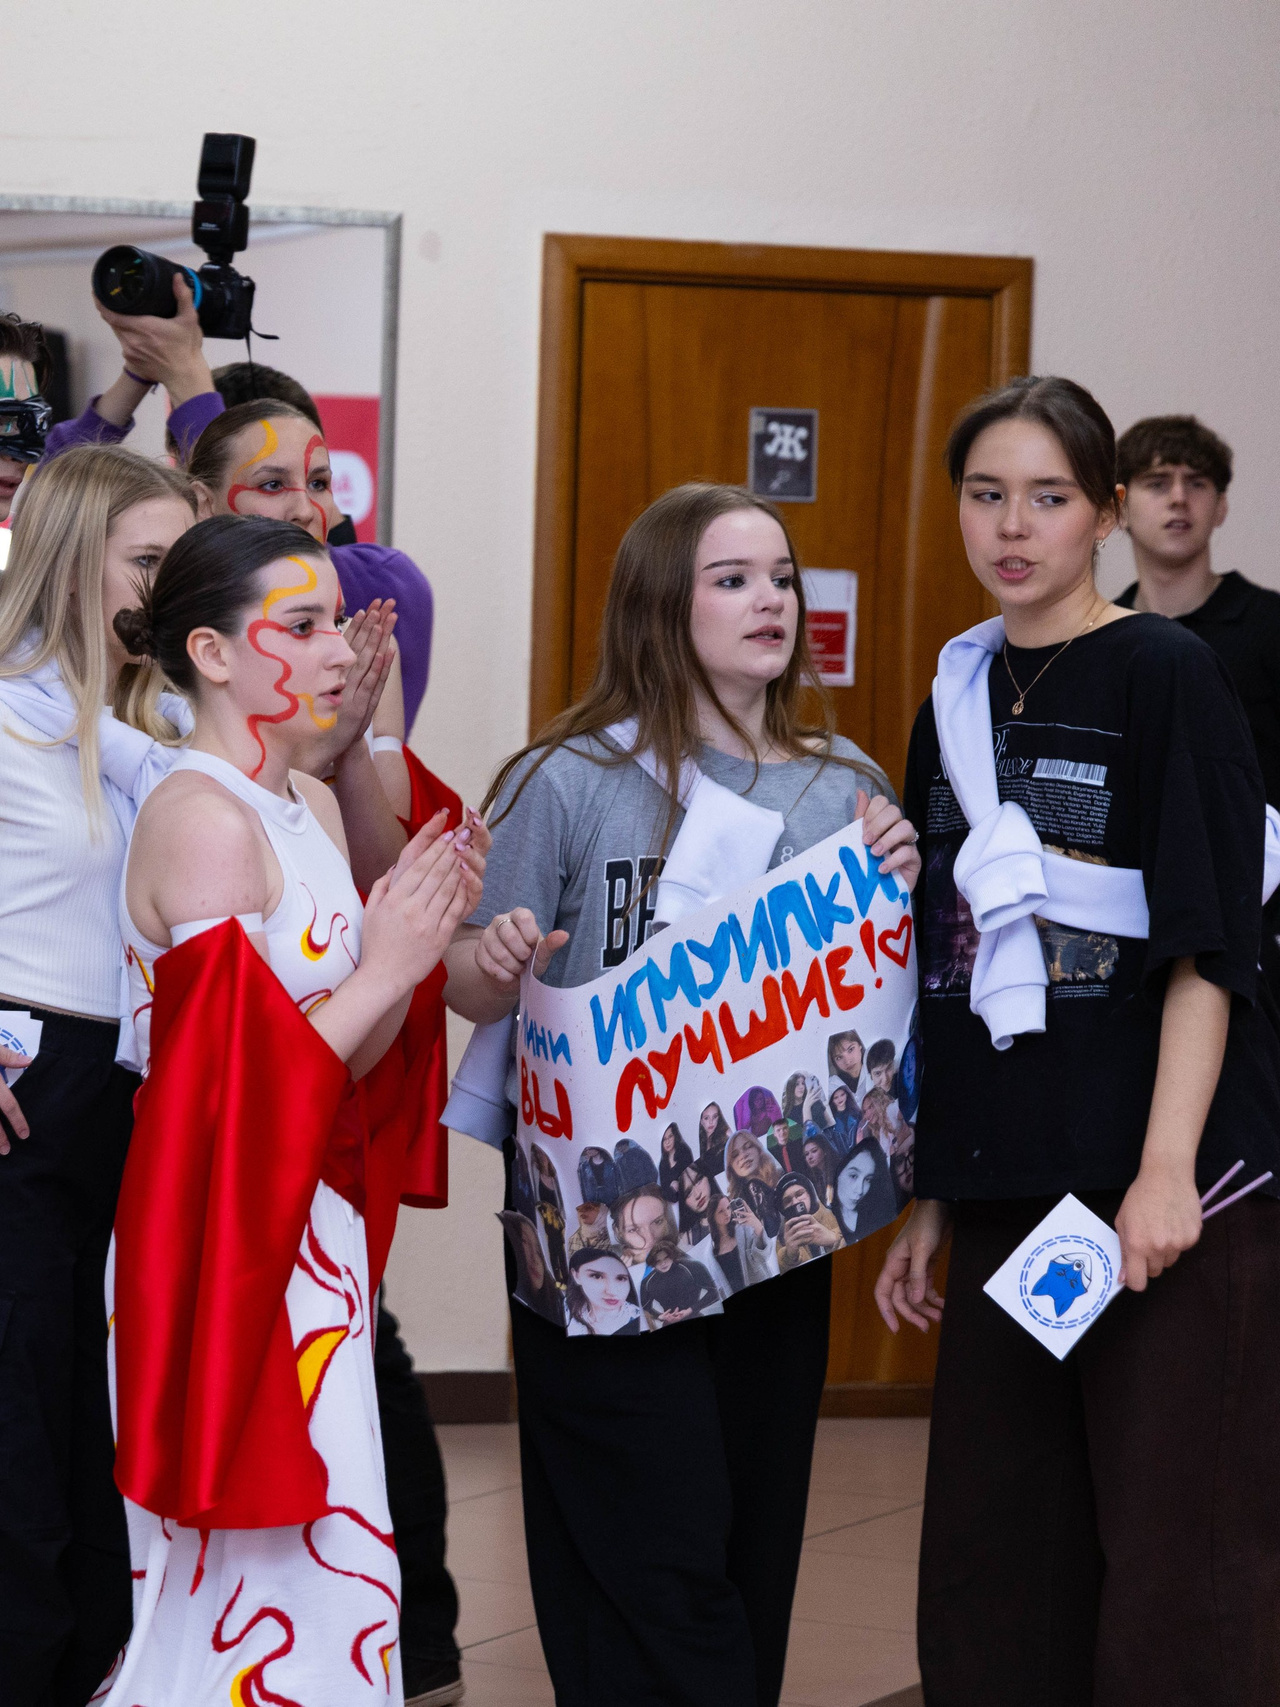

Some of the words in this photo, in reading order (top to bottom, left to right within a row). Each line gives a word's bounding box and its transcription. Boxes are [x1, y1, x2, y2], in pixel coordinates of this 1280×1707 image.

[764, 421, 808, 462] Ж
[521, 1054, 573, 1141] ВЫ
[615, 918, 884, 1133] ЛУЧШИЕ!
